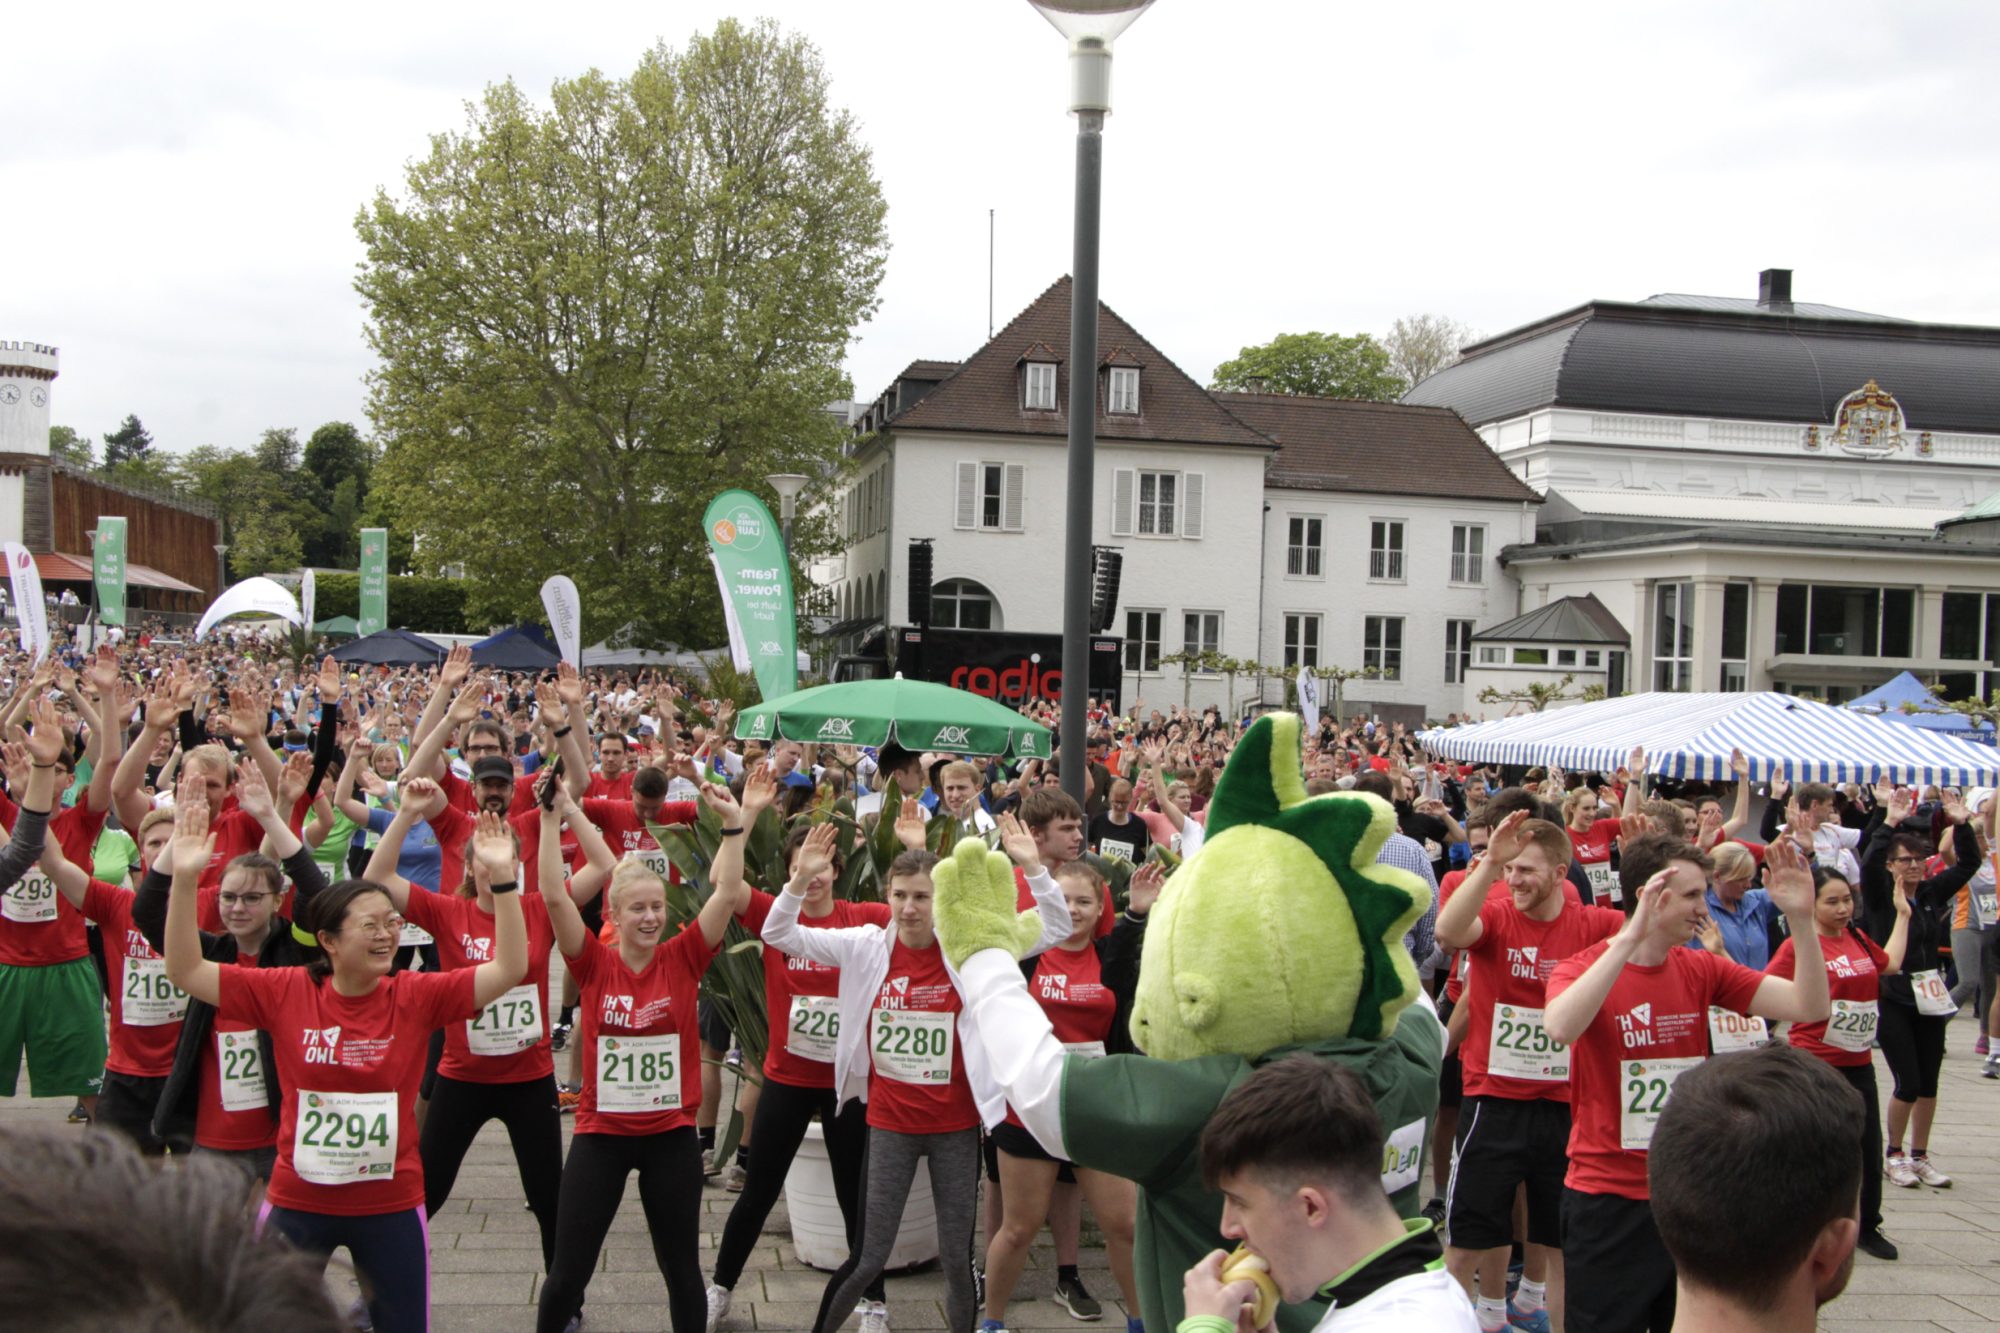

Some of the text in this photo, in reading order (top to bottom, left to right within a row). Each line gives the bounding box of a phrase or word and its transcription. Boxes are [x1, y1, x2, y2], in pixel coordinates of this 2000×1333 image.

[818, 718, 855, 736] AOK
[932, 726, 971, 744] AOK
[5, 878, 52, 900] 293
[130, 944, 152, 959] OWL
[466, 948, 491, 961] OWL
[1507, 947, 1522, 963] TH
[788, 957, 813, 971] OWL
[1511, 963, 1538, 980] OWL
[1837, 967, 1858, 978] OWL
[1038, 974, 1053, 987] TH
[1041, 986, 1068, 1001] OWL
[880, 996, 908, 1010] OWL
[471, 1000, 535, 1030] 2173
[604, 1010, 632, 1029] OWL
[1832, 1011, 1876, 1033] 2282
[302, 1028, 320, 1046] TH
[876, 1025, 947, 1056] 2280
[1623, 1029, 1656, 1049] OWL
[304, 1046, 339, 1065] OWL
[602, 1051, 674, 1082] 2185
[302, 1110, 390, 1149] 2294
